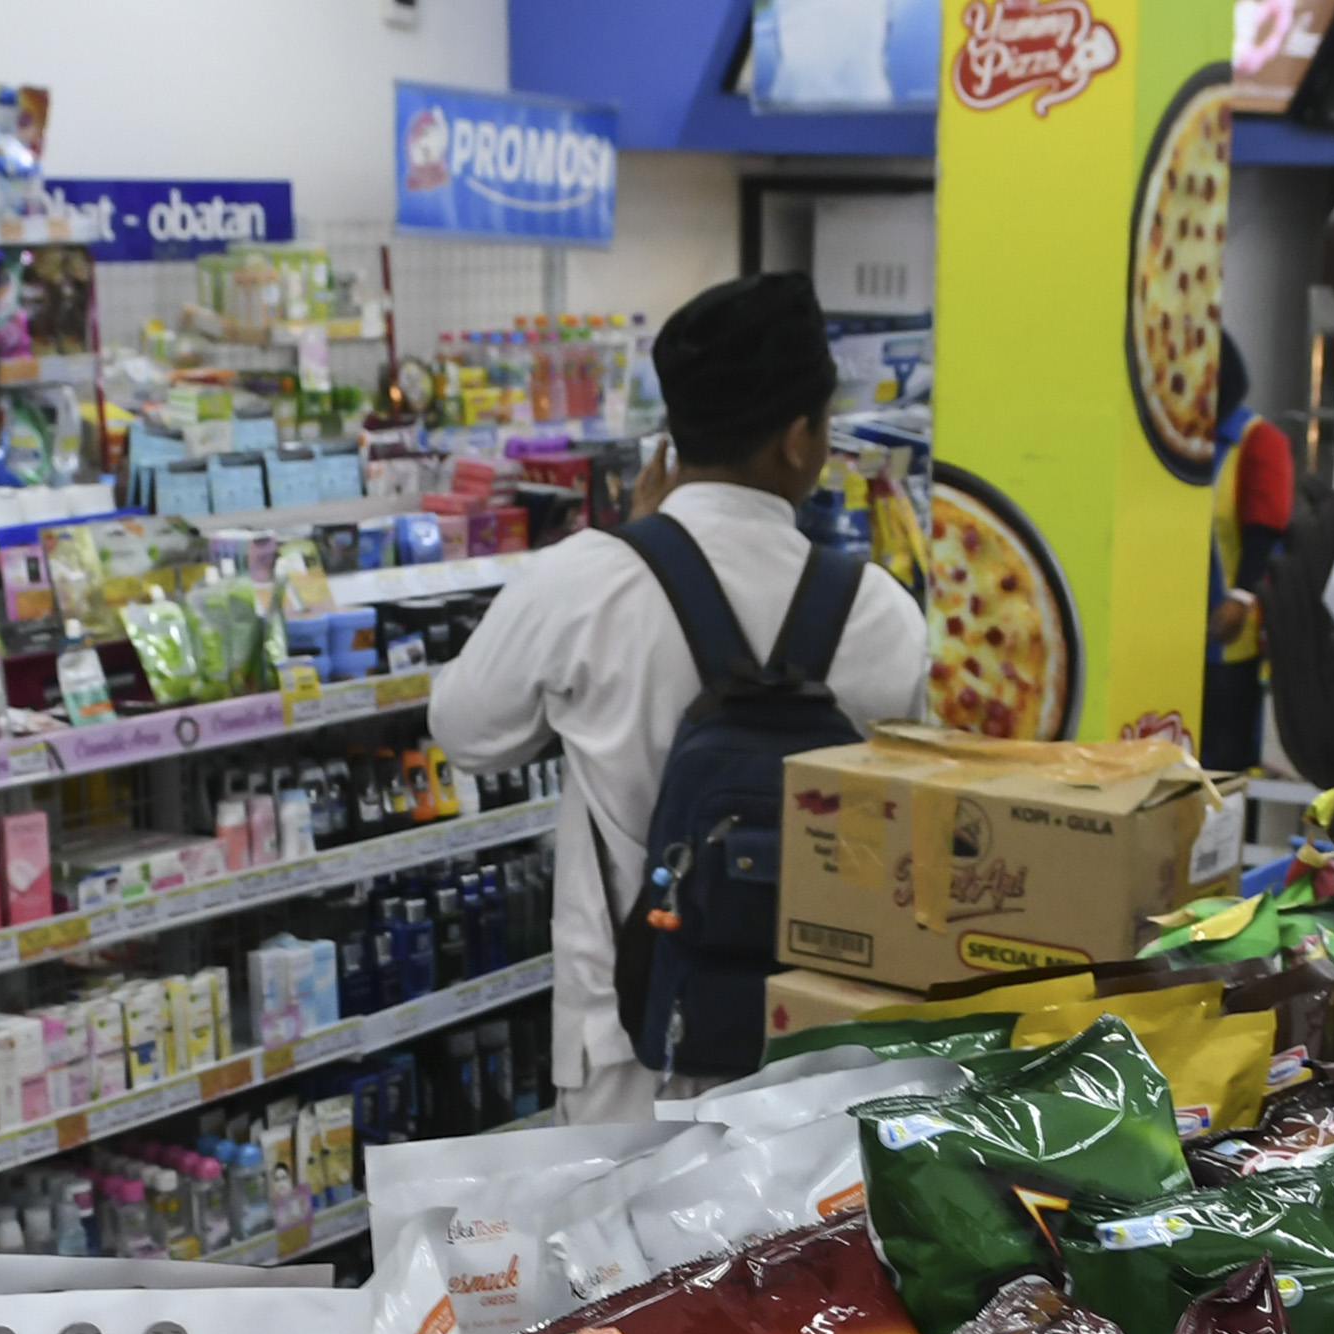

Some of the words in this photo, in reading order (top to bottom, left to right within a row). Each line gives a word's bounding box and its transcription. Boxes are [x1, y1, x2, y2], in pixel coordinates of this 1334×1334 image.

[452, 118, 611, 191] PROMOSI
[148, 189, 266, 241] obatan
[1010, 805, 1050, 826] KOPI
[1067, 815, 1114, 836] GULA
[966, 941, 1036, 970] SPECIAL
